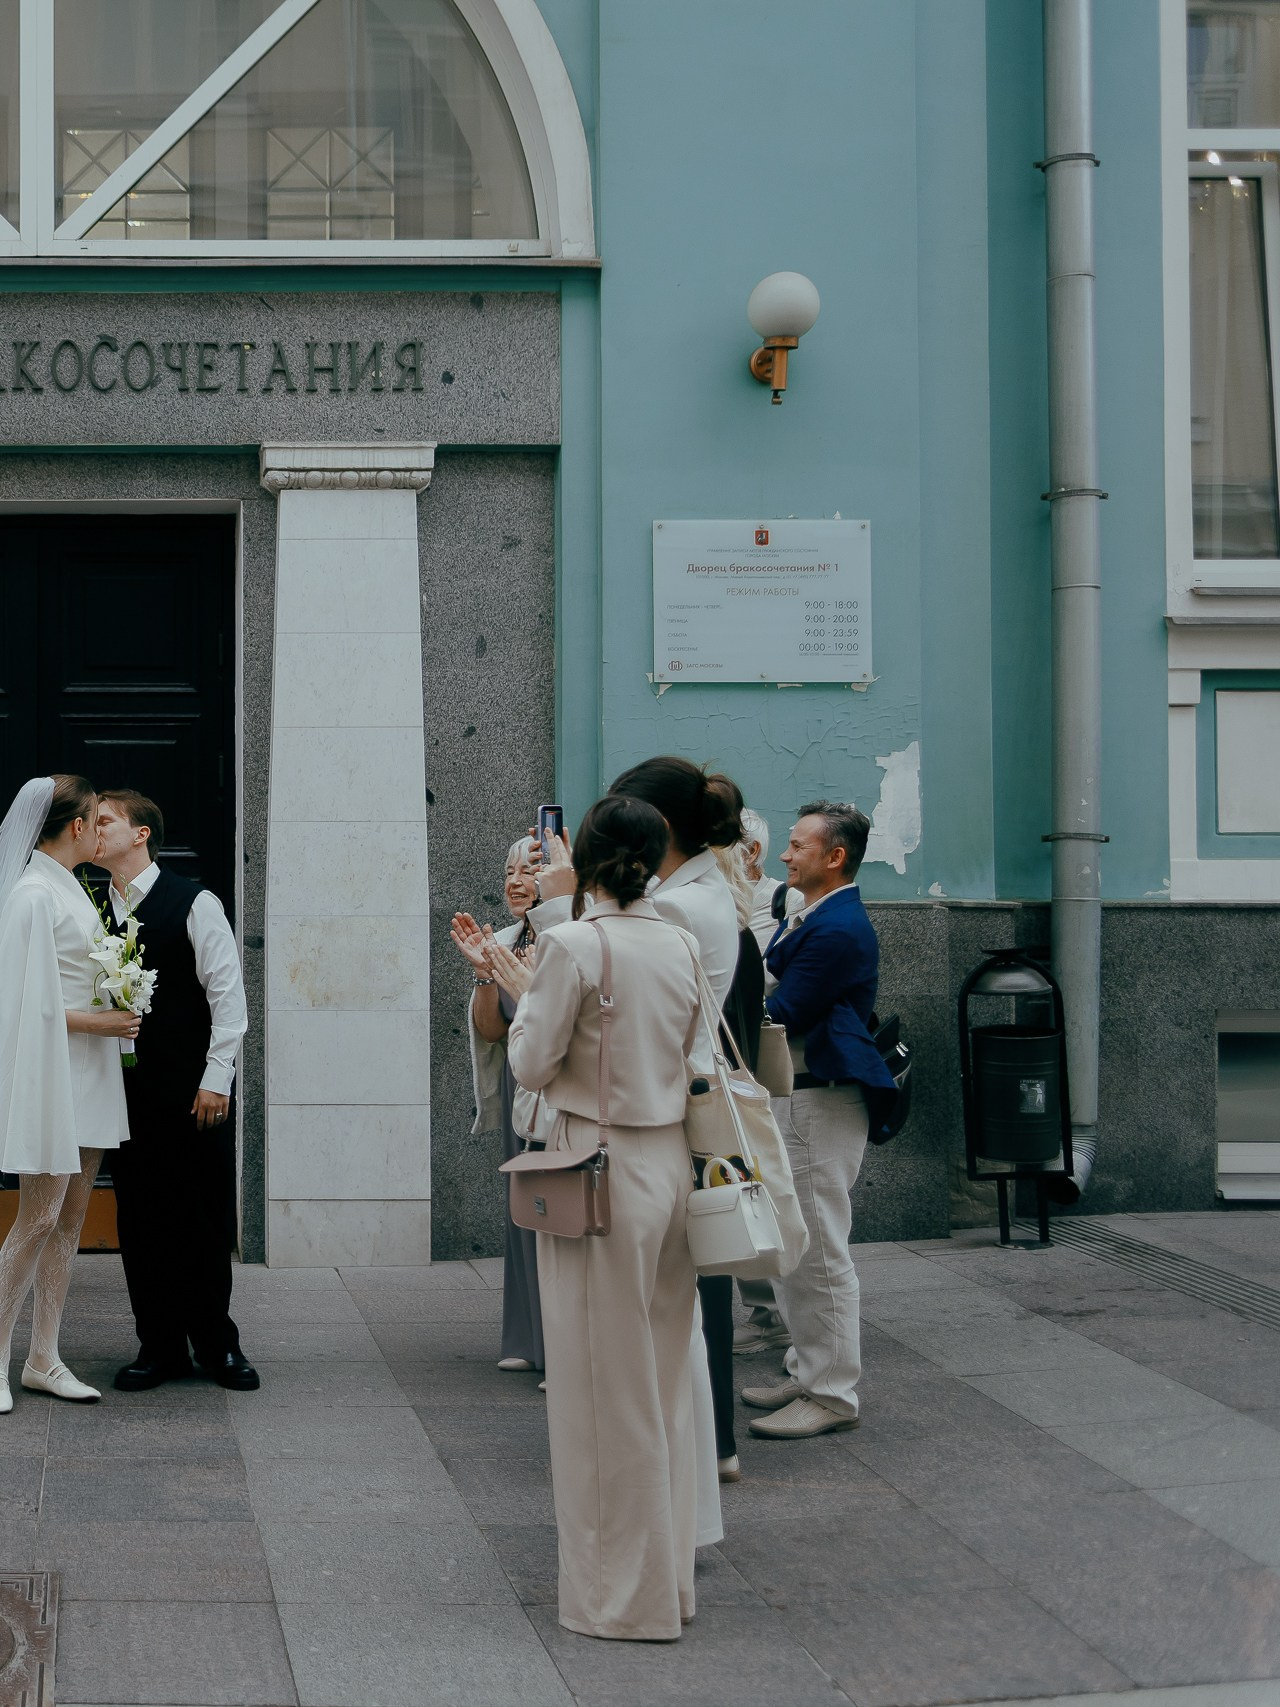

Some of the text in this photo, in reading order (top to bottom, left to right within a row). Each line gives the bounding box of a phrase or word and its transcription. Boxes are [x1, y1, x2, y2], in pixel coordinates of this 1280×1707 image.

[686, 563, 727, 574] Дворец
[729, 563, 815, 574] бракосочетания
[726, 588, 799, 596] РЕЖИМ РАБОТЫ
[804, 600, 825, 609] 9:00
[834, 600, 859, 609] 18:00
[804, 614, 825, 623] 9:00
[832, 614, 859, 623] 20:00
[804, 628, 825, 637] 9:00
[832, 628, 859, 637] 23:59
[798, 642, 826, 651] 00:00
[834, 642, 859, 651] 19:00
